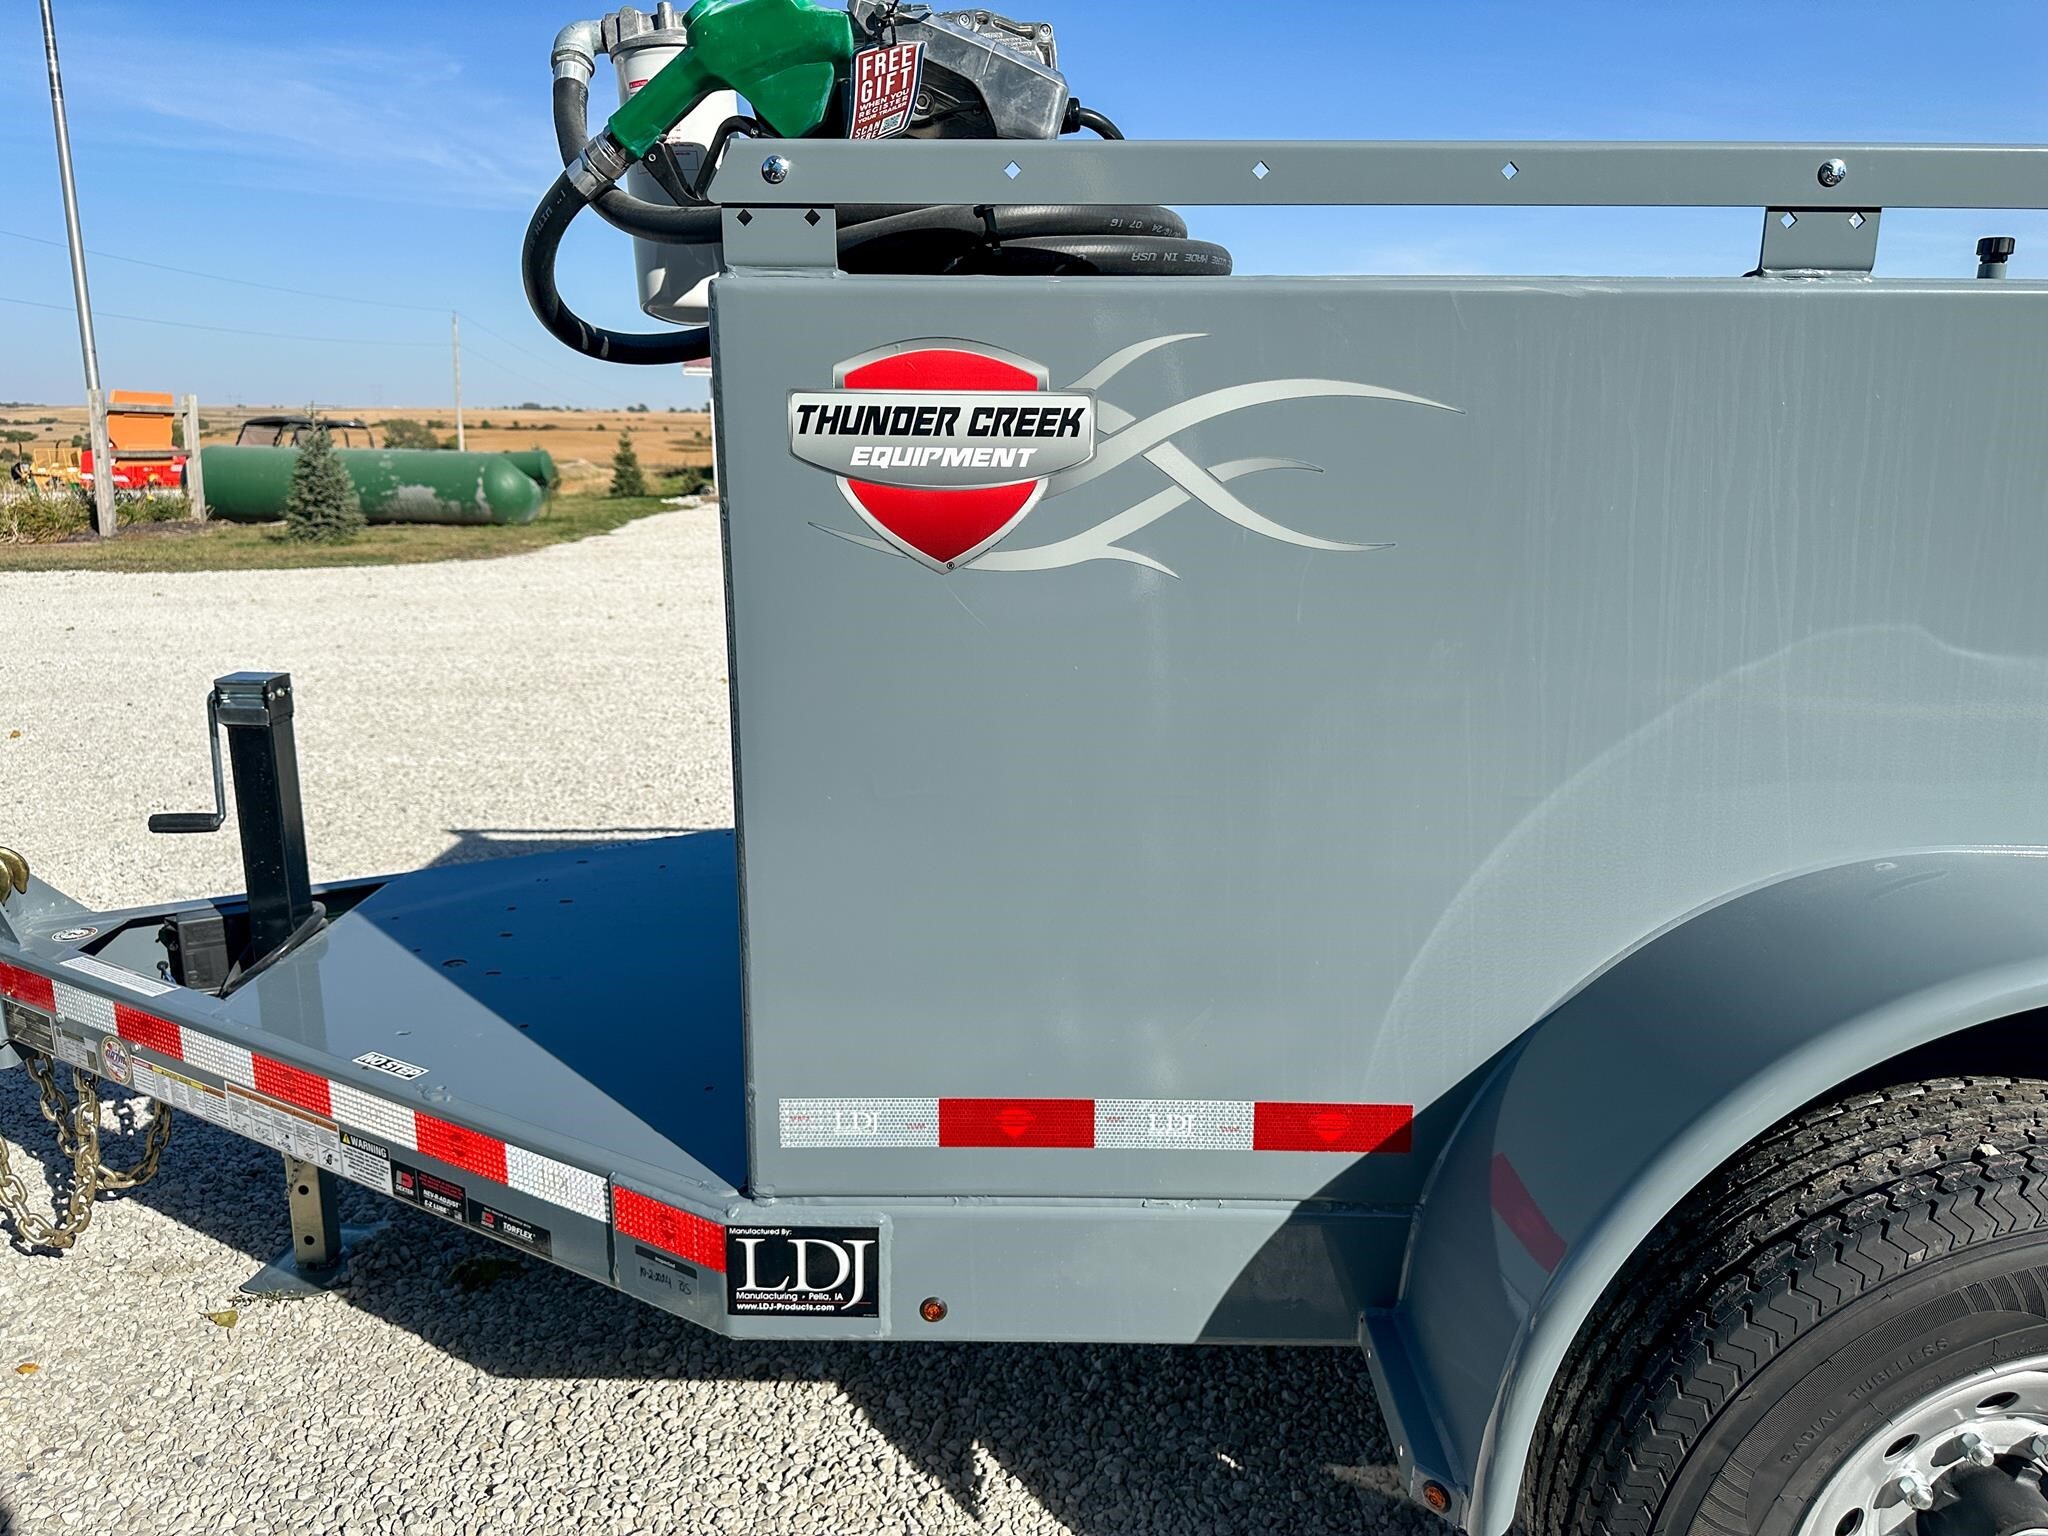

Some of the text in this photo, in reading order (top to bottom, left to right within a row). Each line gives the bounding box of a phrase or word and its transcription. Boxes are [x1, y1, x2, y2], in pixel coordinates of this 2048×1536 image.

[862, 45, 915, 80] FREE
[861, 66, 913, 103] GIFT
[859, 88, 910, 112] WHEN YOU
[859, 95, 909, 119] REGISTER
[858, 101, 908, 124] YOUR TRAILER
[855, 120, 881, 138] SCAN
[1131, 252, 1157, 261] USA
[1163, 252, 1178, 261] IN
[1185, 253, 1208, 263] MADE
[796, 404, 1086, 437] THUNDER CREEK
[849, 446, 1038, 469] EQUIPMENT
[360, 1054, 422, 1076] NO STEP
[834, 1111, 879, 1134] LDJ
[1150, 1114, 1195, 1136] LDJ
[350, 1135, 387, 1158] WARNING
[503, 1222, 533, 1240] TORFLEX
[729, 1227, 792, 1236] Manufactured By:
[735, 1238, 876, 1310] LDJ
[736, 1292, 798, 1301] Manufacturing
[808, 1292, 831, 1301] Pella,
[736, 1302, 835, 1311] www.LDJ-Products.com
[1780, 1408, 1841, 1464] RADIAL
[1848, 1337, 1949, 1400] TUBELESS
